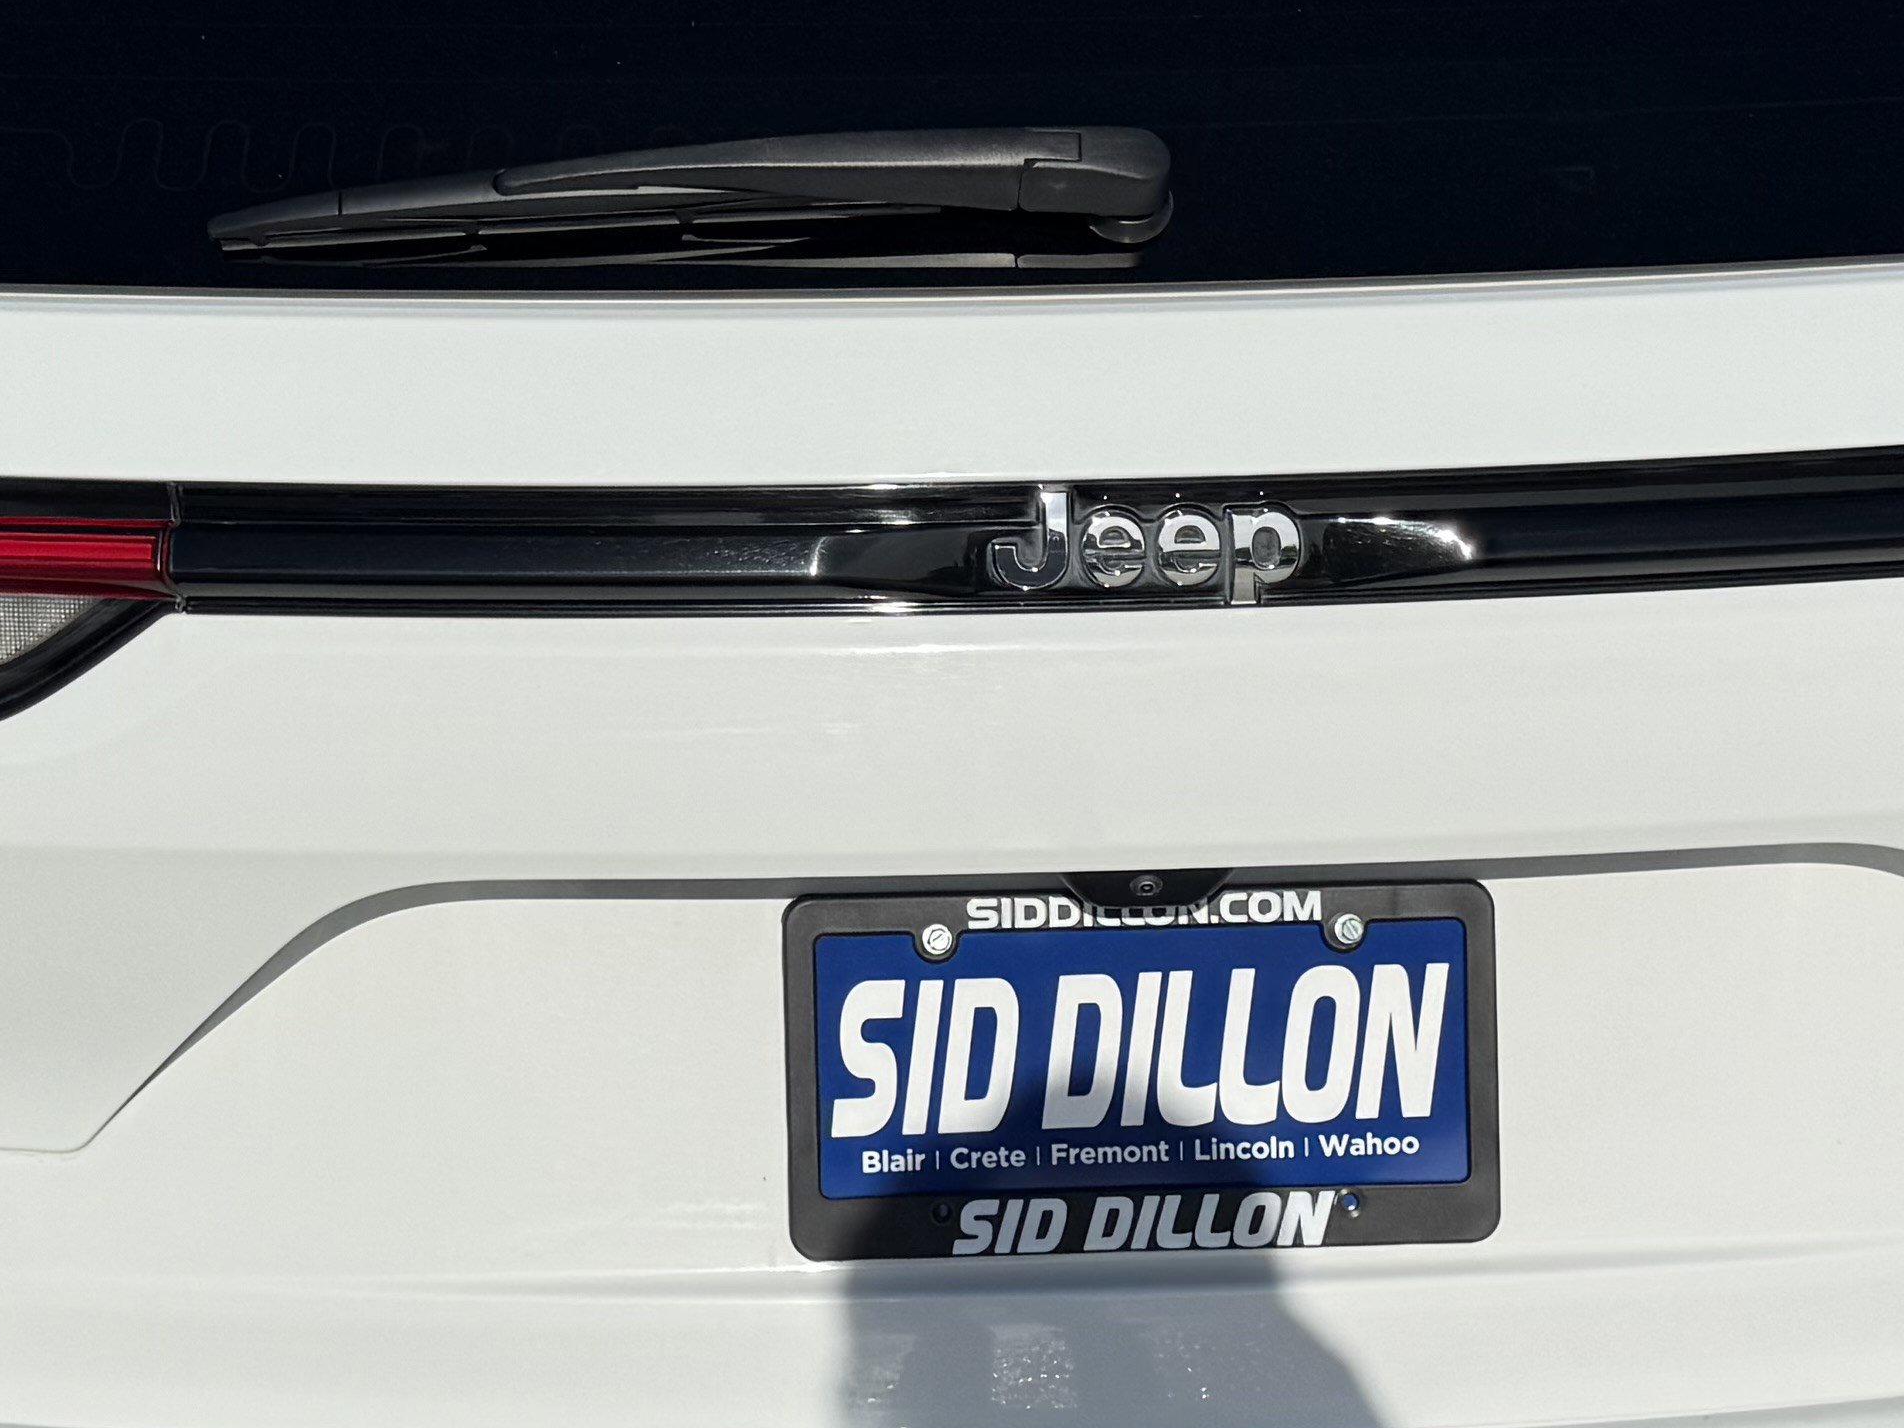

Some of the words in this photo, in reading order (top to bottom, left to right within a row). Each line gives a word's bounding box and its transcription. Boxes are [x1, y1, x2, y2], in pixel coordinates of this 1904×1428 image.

[991, 489, 1301, 606] Jeep
[965, 890, 1323, 931] SIDDILLON.COM
[831, 977, 1020, 1138] SID
[1041, 963, 1450, 1130] DILLON
[862, 1148, 926, 1174] Blair
[950, 1145, 1027, 1170] Crete
[1050, 1140, 1170, 1167] Fremont
[1194, 1134, 1295, 1162] Lincoln
[1318, 1132, 1421, 1157] Wahoo
[952, 1198, 1071, 1256] SID
[1083, 1190, 1336, 1251] DILLON
